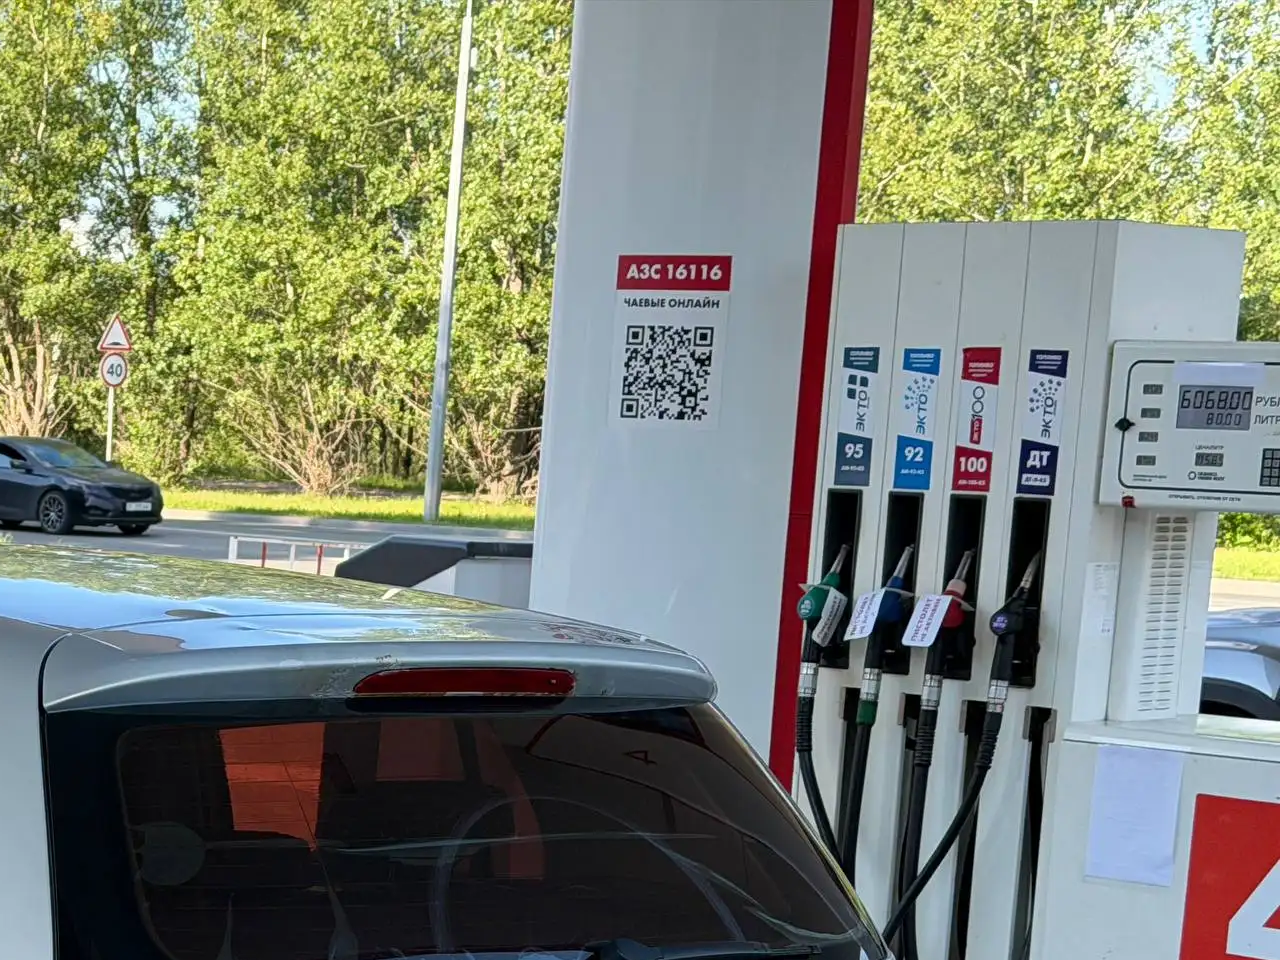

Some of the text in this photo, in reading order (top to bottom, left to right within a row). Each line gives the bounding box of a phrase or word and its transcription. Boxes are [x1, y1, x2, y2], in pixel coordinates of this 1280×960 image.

[626, 264, 722, 280] АЗС 16116
[624, 297, 720, 309] ЧАЕВЫЕ ОНЛАЙН
[107, 363, 123, 377] 40
[1255, 396, 1280, 407] РУБ
[856, 390, 868, 432] ЭКТО
[916, 393, 928, 435] ЭКТО
[1041, 396, 1054, 438] ЭКТО
[845, 443, 864, 458] 95
[904, 447, 924, 462] 92
[959, 457, 987, 472] 100
[1026, 451, 1051, 468] ДТ
